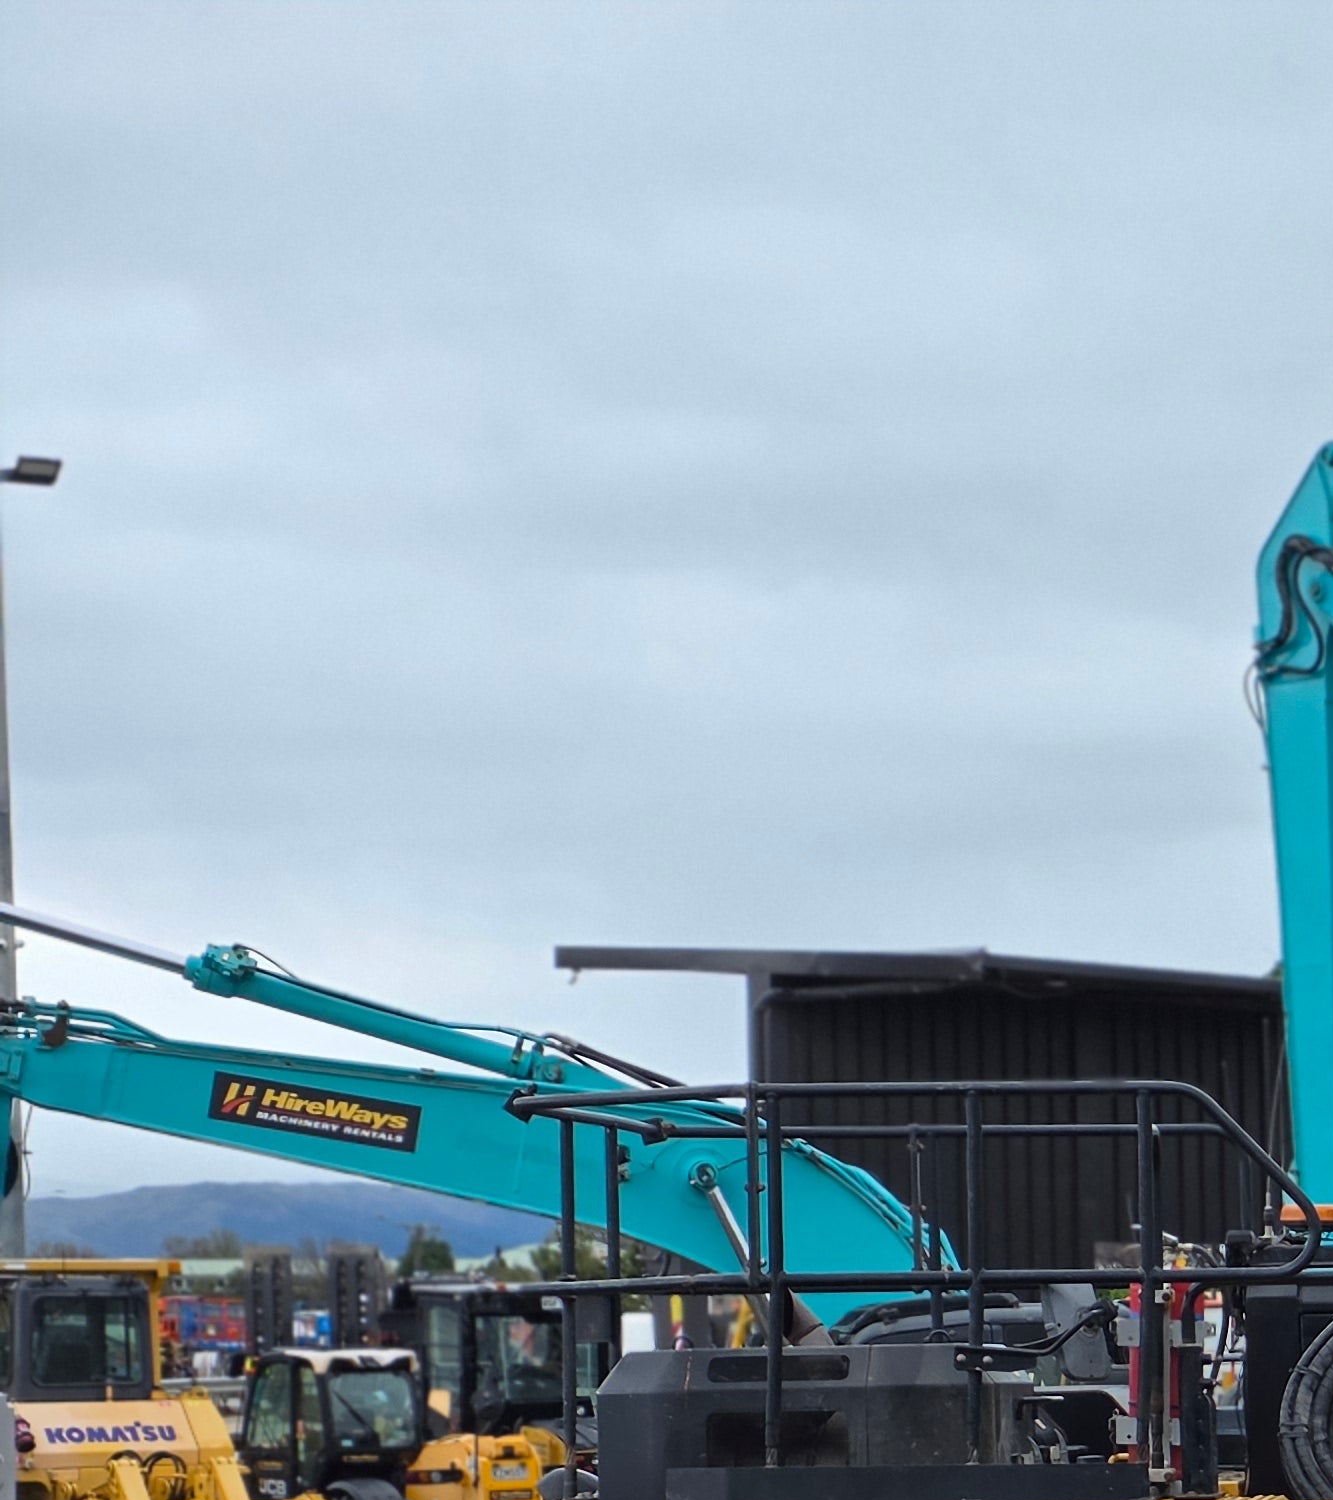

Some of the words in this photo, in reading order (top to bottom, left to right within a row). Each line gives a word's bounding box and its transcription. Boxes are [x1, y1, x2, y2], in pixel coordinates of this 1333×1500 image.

[261, 1088, 409, 1130] HireWays
[256, 1111, 340, 1133] MACHINERY
[343, 1126, 404, 1144] RENTALS
[45, 1422, 177, 1444] KOMATSU
[259, 1478, 287, 1495] JCB
